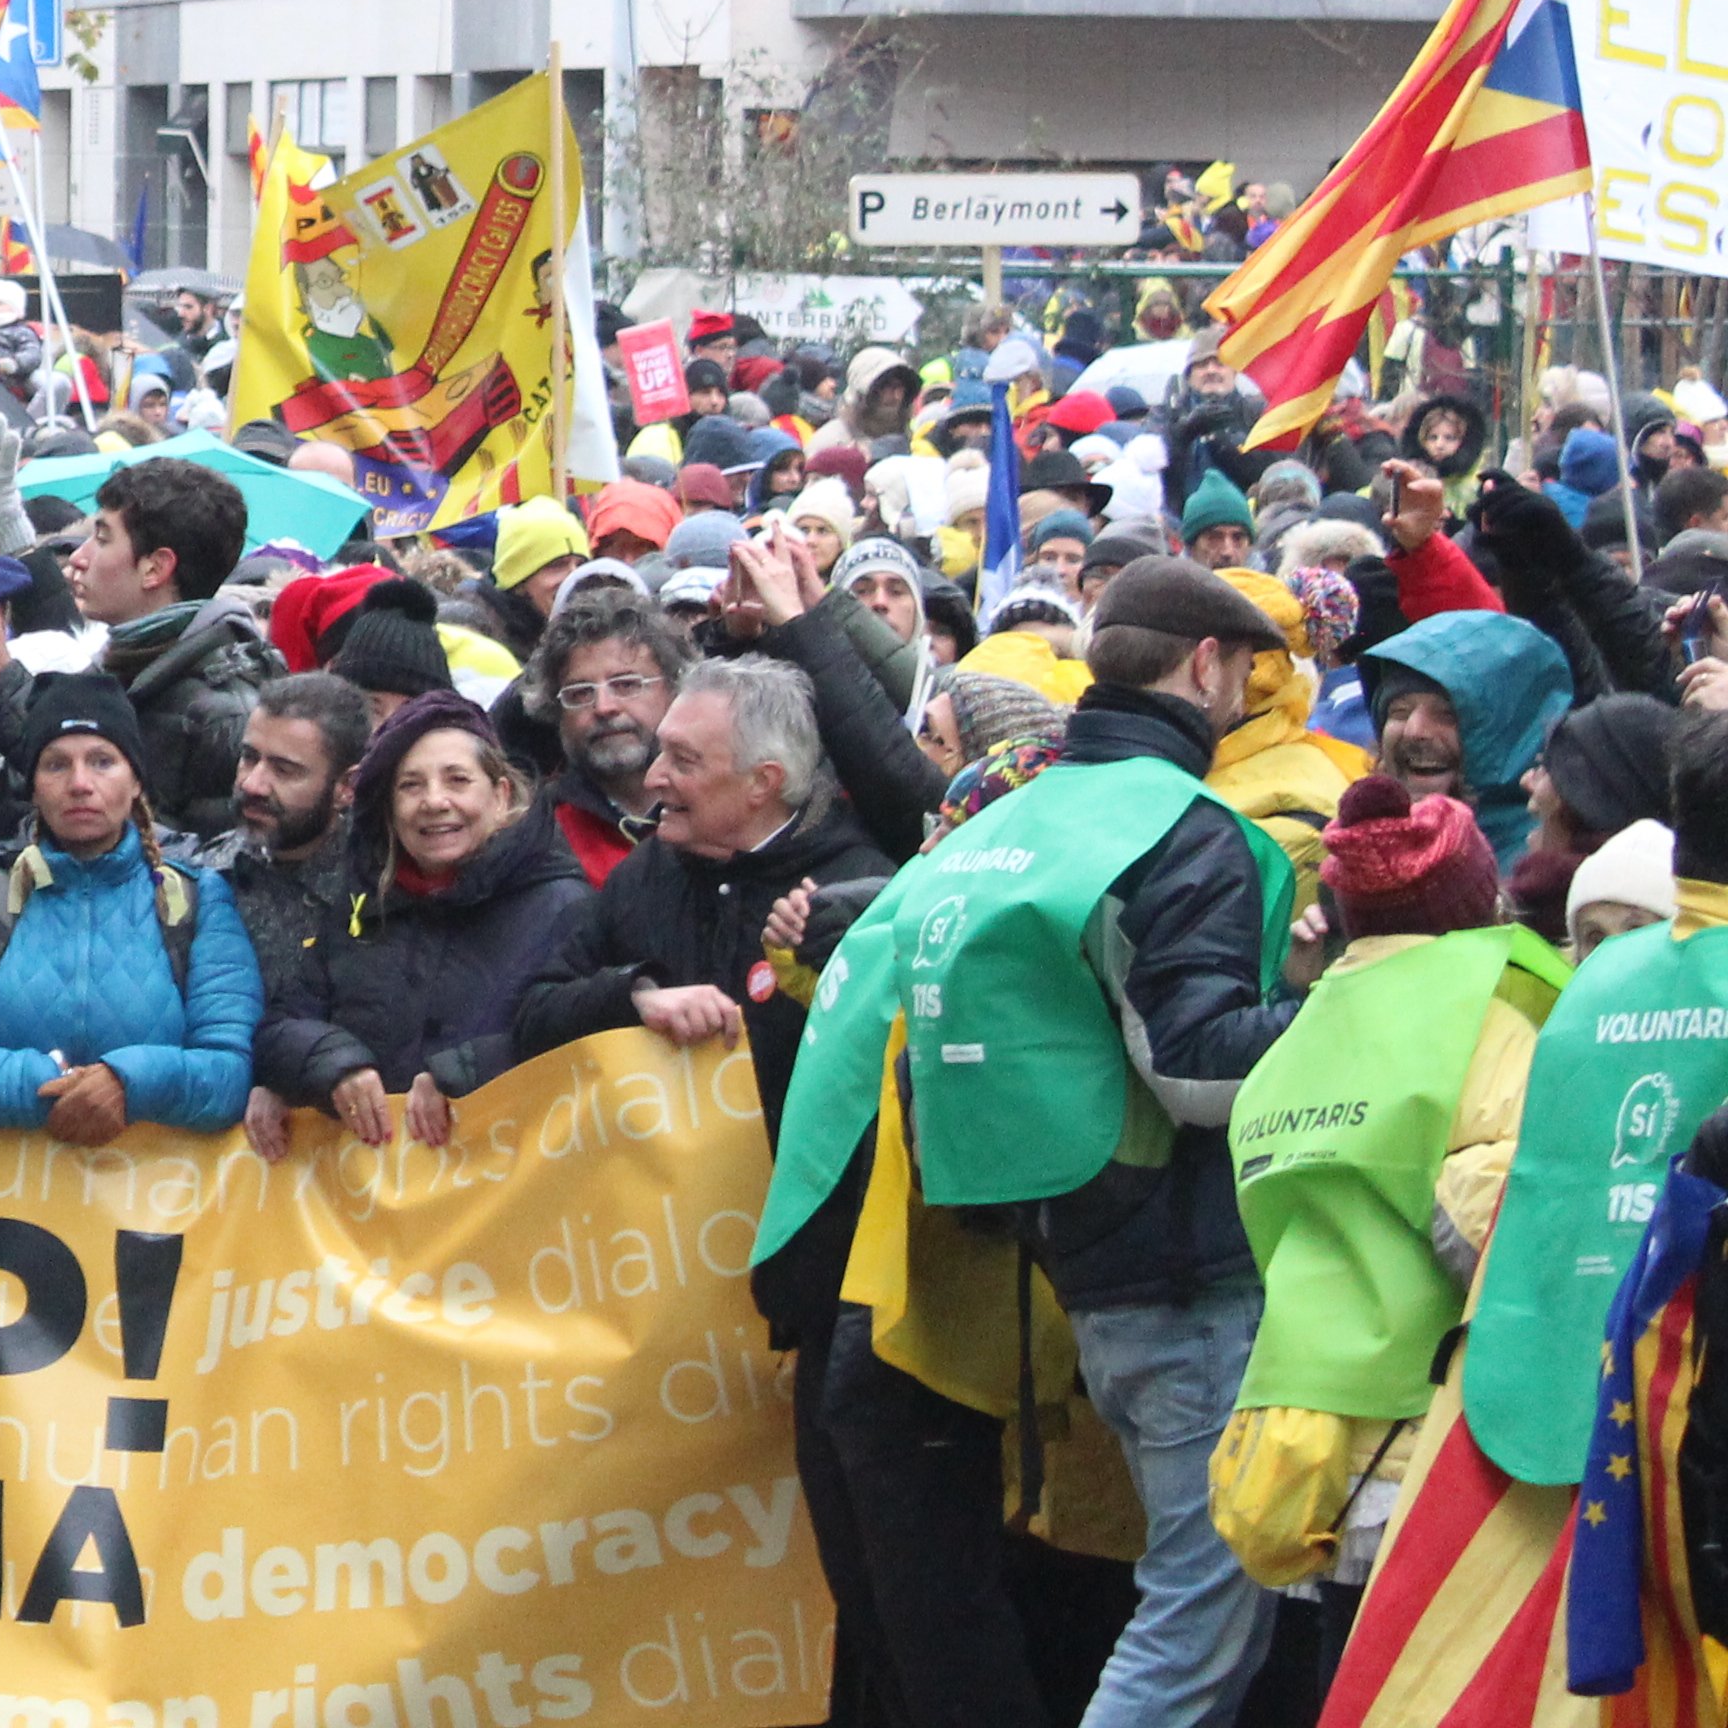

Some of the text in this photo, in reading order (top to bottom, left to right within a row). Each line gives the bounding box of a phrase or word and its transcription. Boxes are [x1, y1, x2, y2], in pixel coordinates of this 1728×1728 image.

[859, 190, 1084, 230] P Berlaymont
[637, 368, 676, 391] UP!
[372, 506, 430, 528] CRACY
[537, 1045, 764, 1162] dialo
[1237, 1100, 1370, 1147] VOLUNTARIS
[195, 1256, 495, 1374] justice
[528, 1194, 757, 1315] dialo
[340, 1360, 615, 1480] rights
[181, 1478, 799, 1623] democracy
